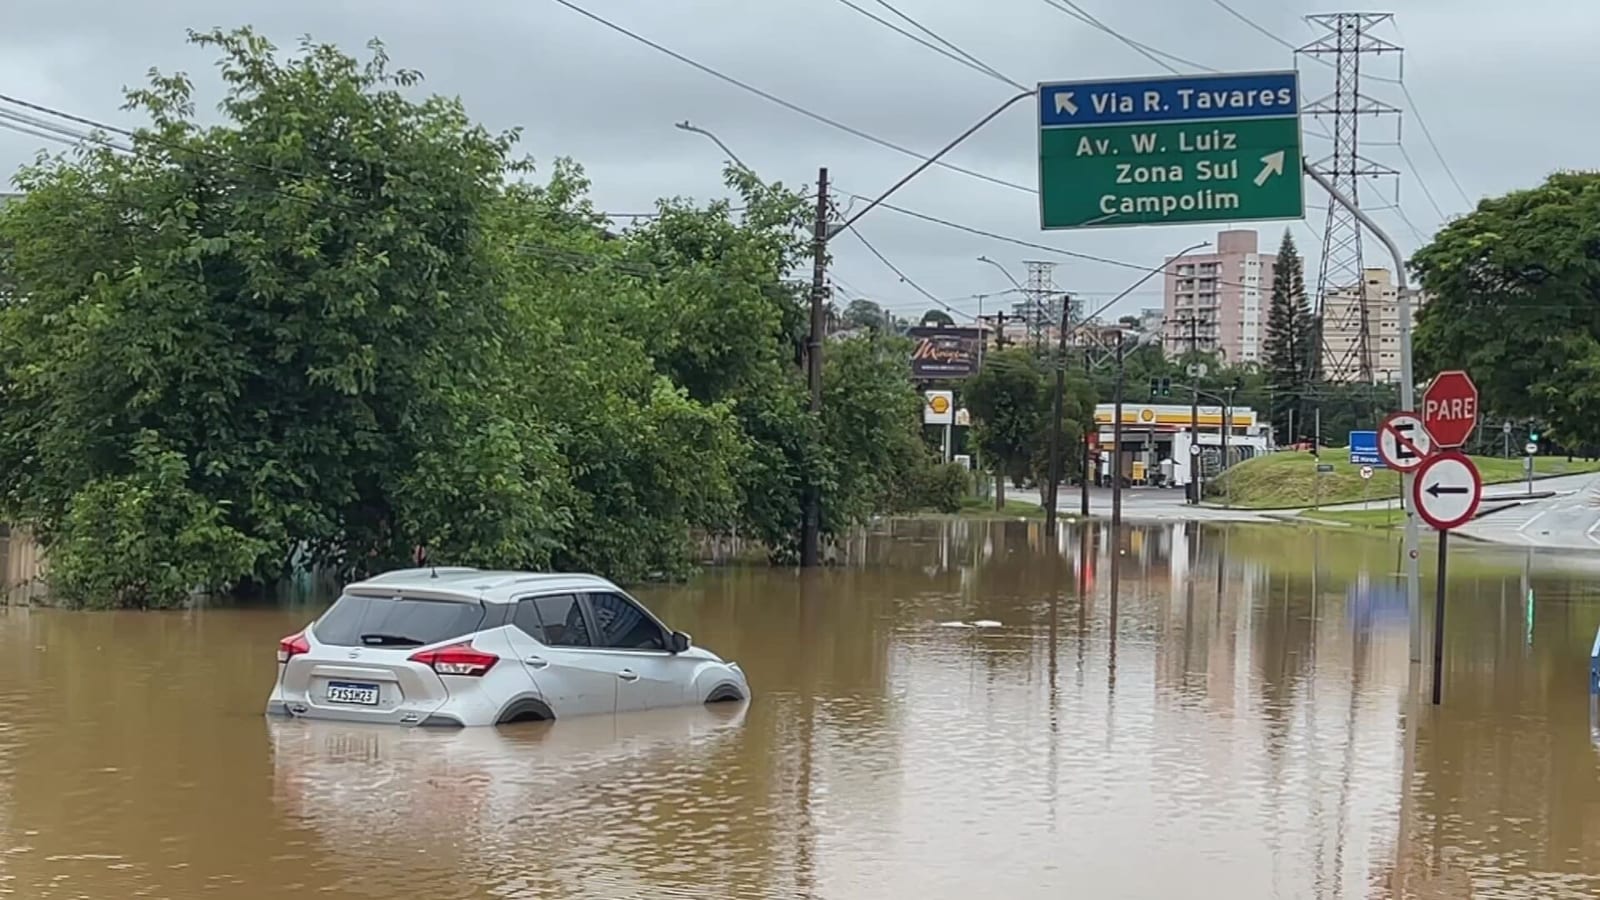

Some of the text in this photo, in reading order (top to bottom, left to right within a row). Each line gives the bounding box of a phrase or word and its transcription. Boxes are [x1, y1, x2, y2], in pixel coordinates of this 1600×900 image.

[1091, 87, 1291, 114] Via R. Tavares
[1076, 129, 1237, 157] Av. W. Luiz
[1116, 160, 1238, 184] Zona Sul
[1099, 189, 1239, 216] Campolim
[1425, 397, 1474, 422] PARE
